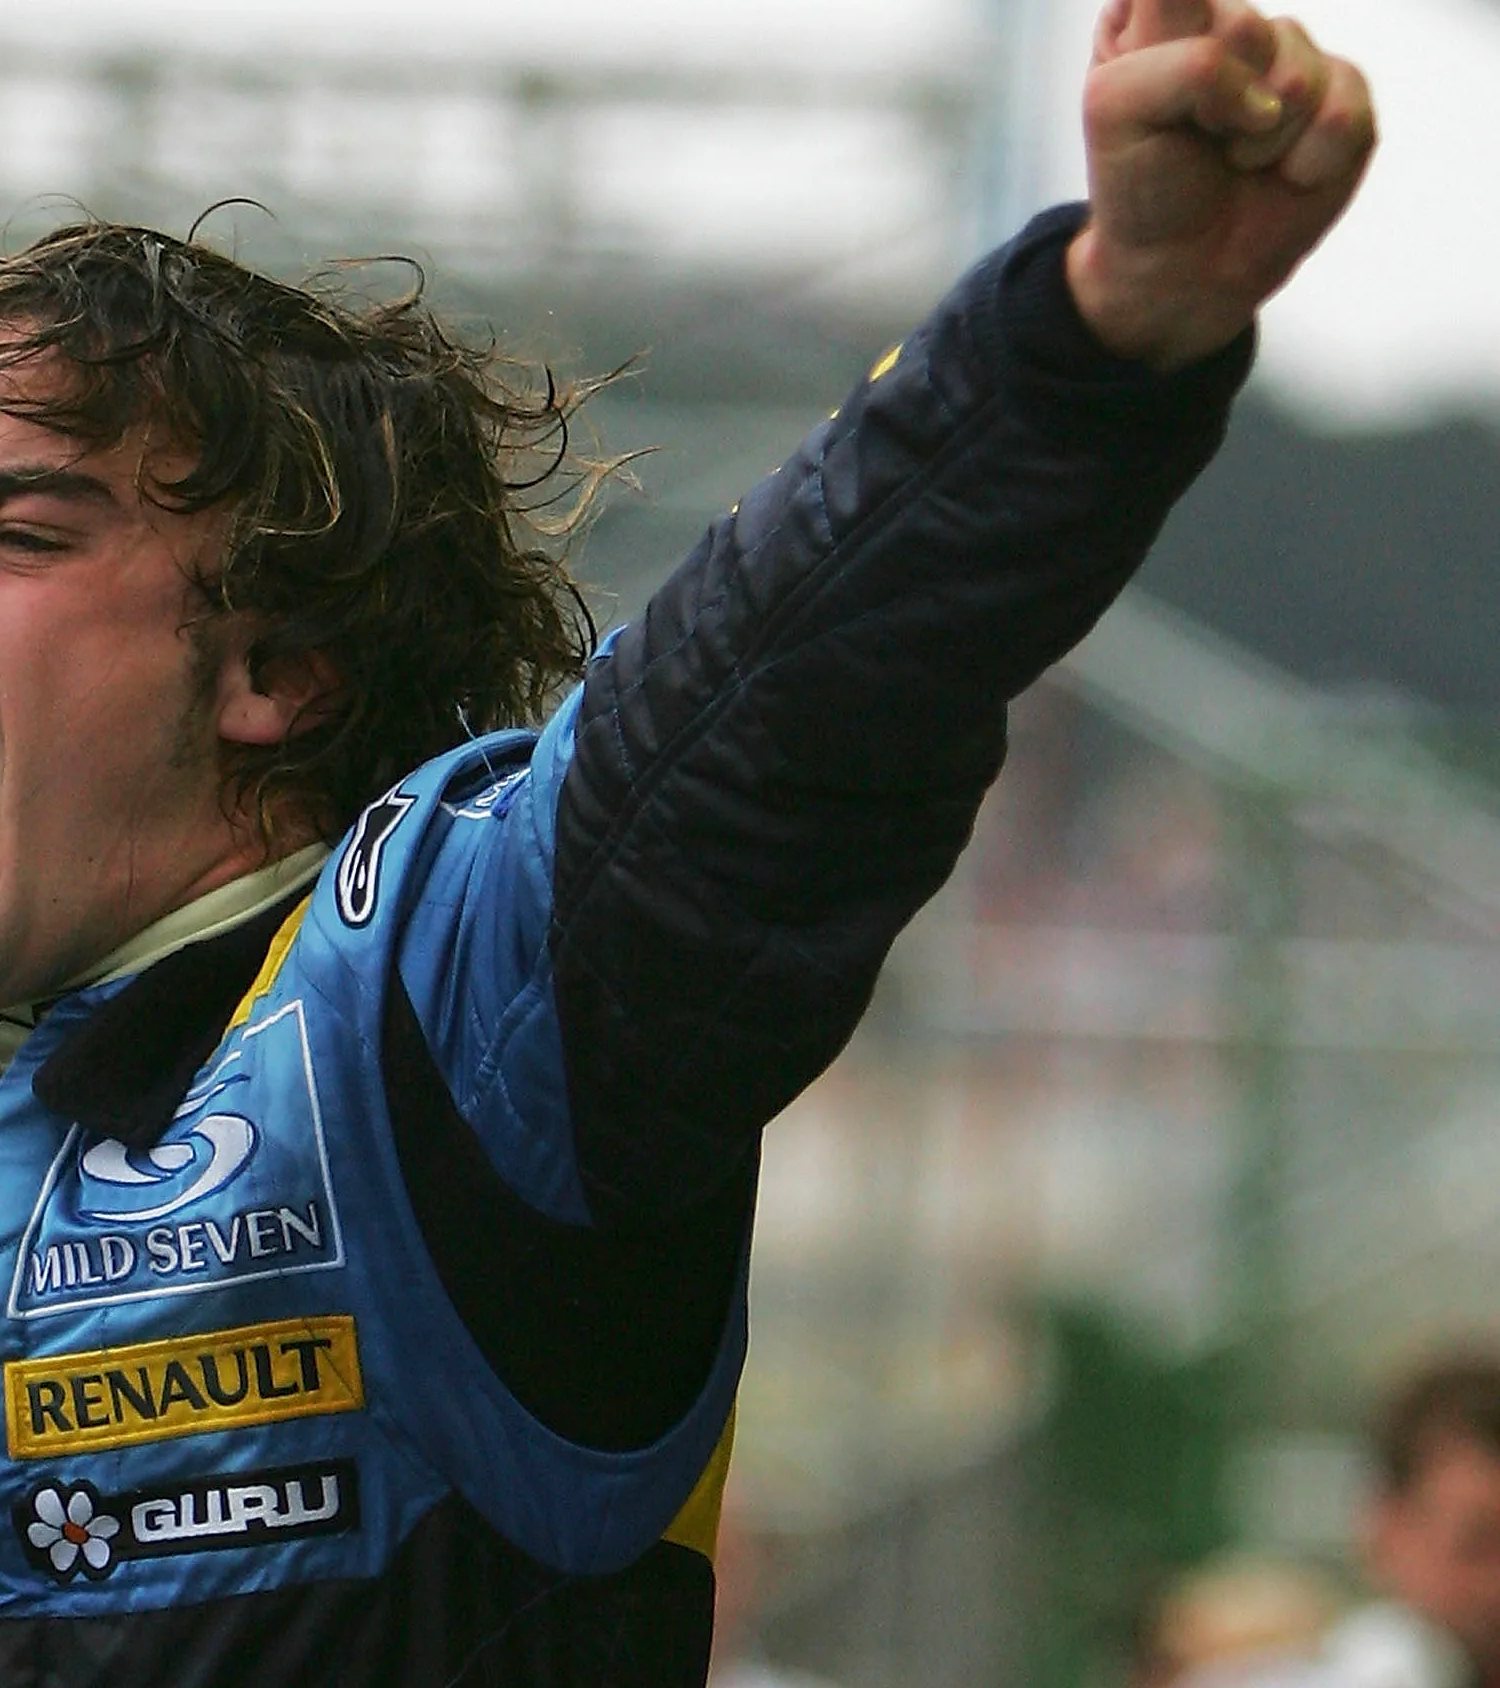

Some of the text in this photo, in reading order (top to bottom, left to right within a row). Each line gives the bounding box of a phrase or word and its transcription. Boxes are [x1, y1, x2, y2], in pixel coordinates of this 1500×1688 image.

[26, 1203, 320, 1293] MILD SEVEN
[27, 1340, 331, 1435] RENAULT
[131, 1476, 339, 1542] GURU
